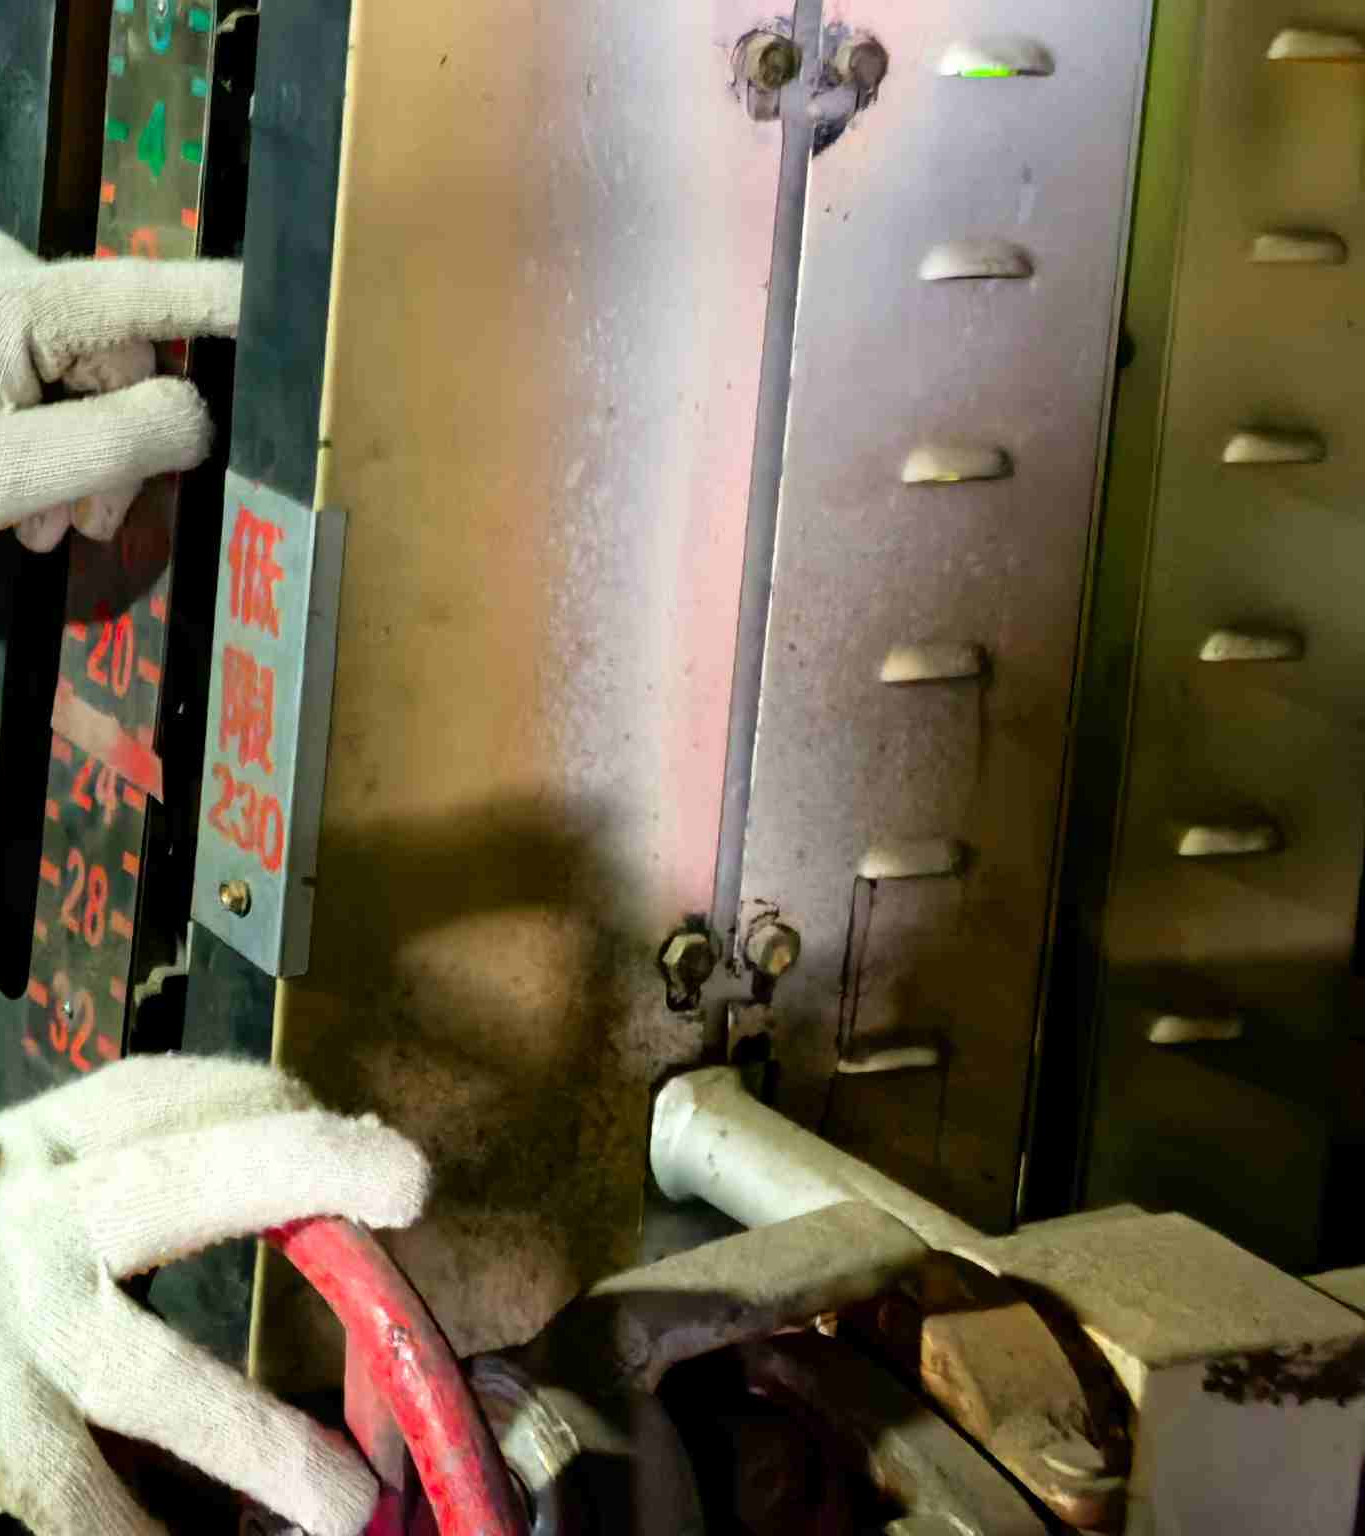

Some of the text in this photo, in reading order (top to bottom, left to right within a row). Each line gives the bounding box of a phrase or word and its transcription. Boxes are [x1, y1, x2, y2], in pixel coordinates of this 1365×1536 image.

[137, 100, 166, 180] 4
[87, 613, 133, 699] 20
[207, 762, 286, 875] 230
[61, 847, 108, 946] 28
[49, 970, 95, 1072] 32
